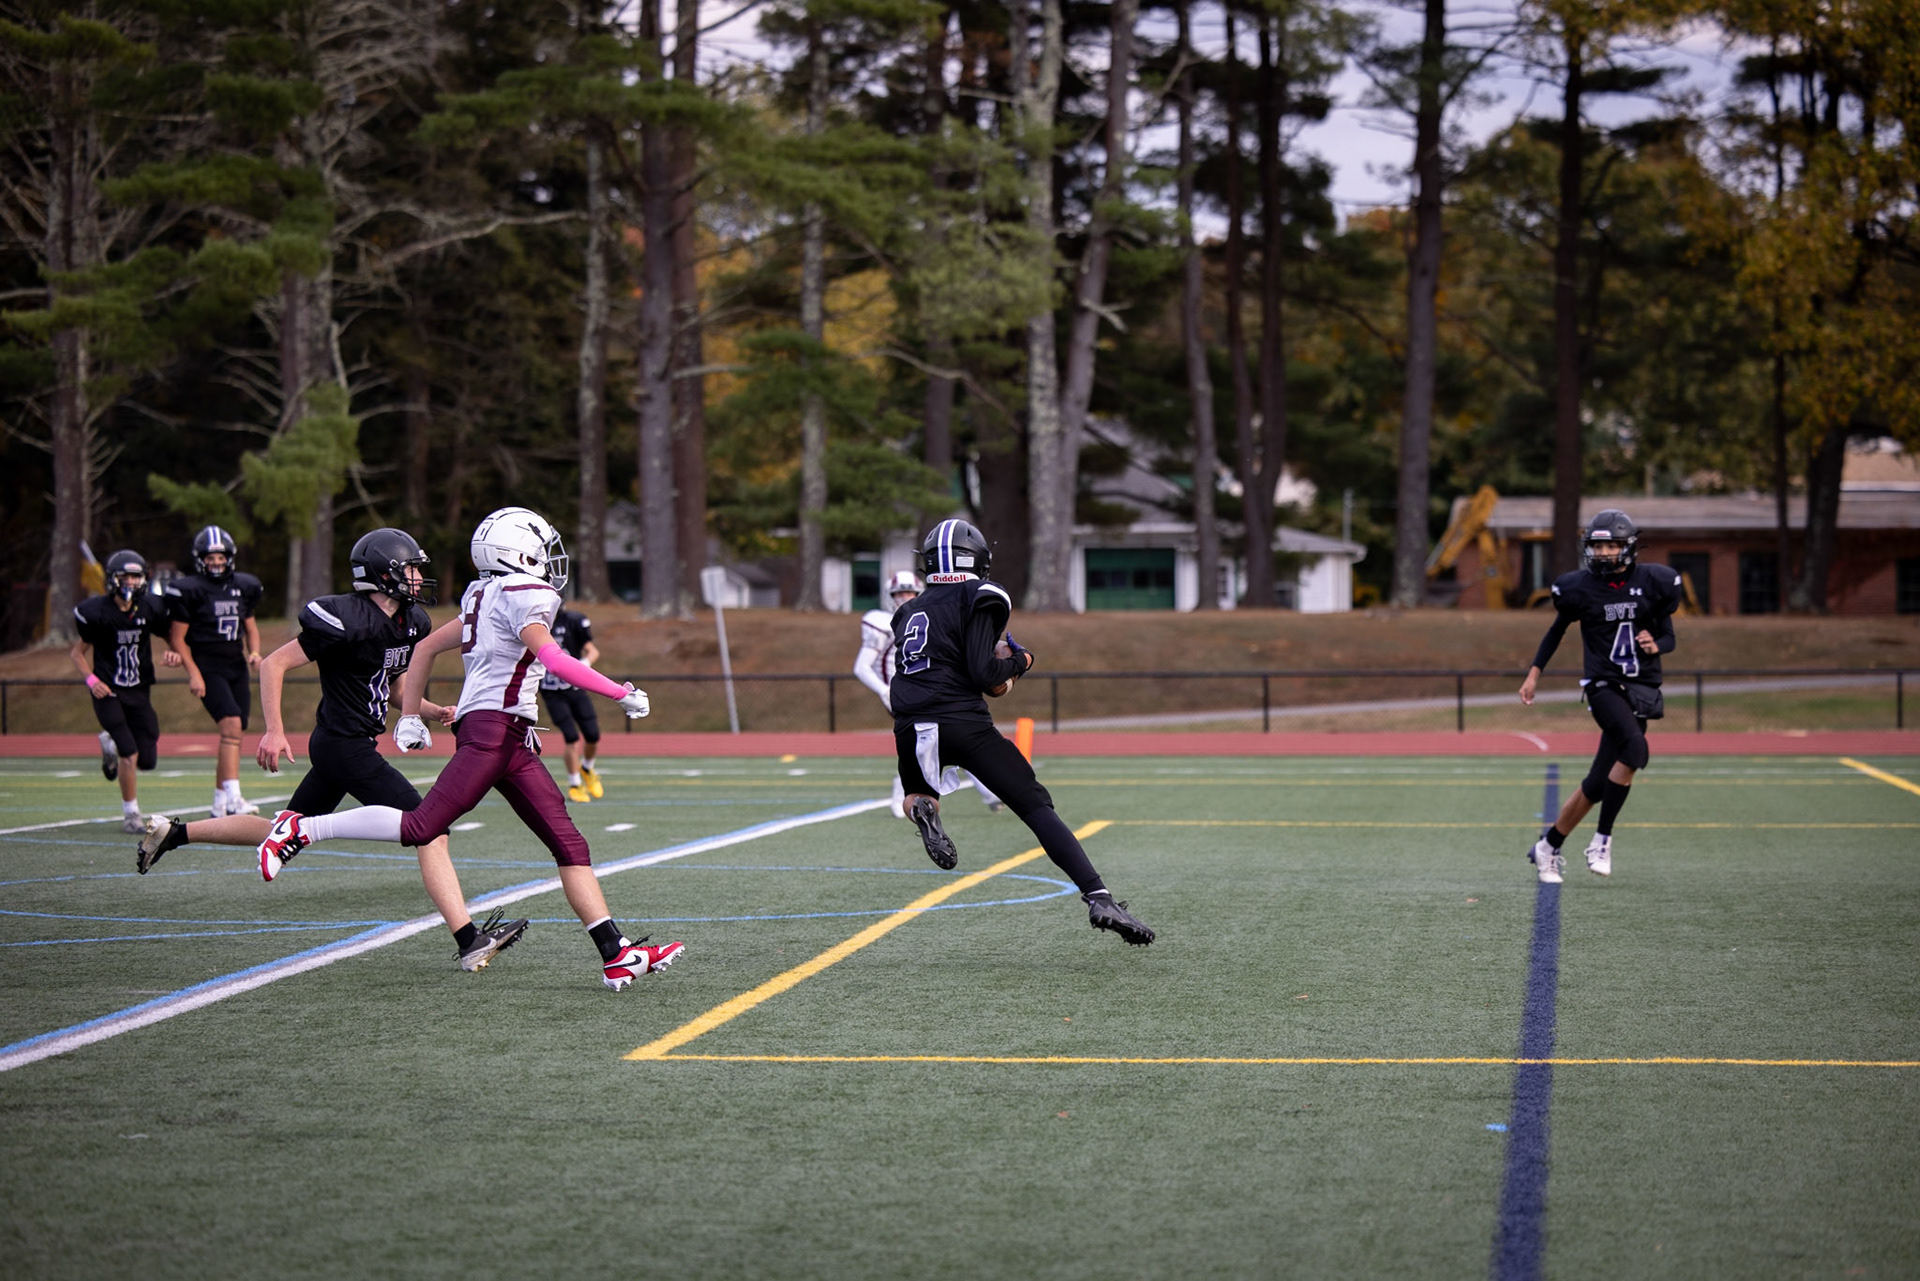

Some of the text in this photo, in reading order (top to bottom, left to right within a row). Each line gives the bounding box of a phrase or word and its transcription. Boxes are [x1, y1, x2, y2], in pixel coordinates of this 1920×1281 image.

[932, 574, 967, 583] Riddell
[214, 601, 239, 616] BVT
[1604, 602, 1638, 621] BVT
[117, 630, 142, 644] BVT
[218, 616, 239, 641] 7
[902, 611, 931, 675] 2
[1609, 621, 1640, 677] 4
[114, 643, 141, 687] 11
[383, 645, 410, 668] BVT
